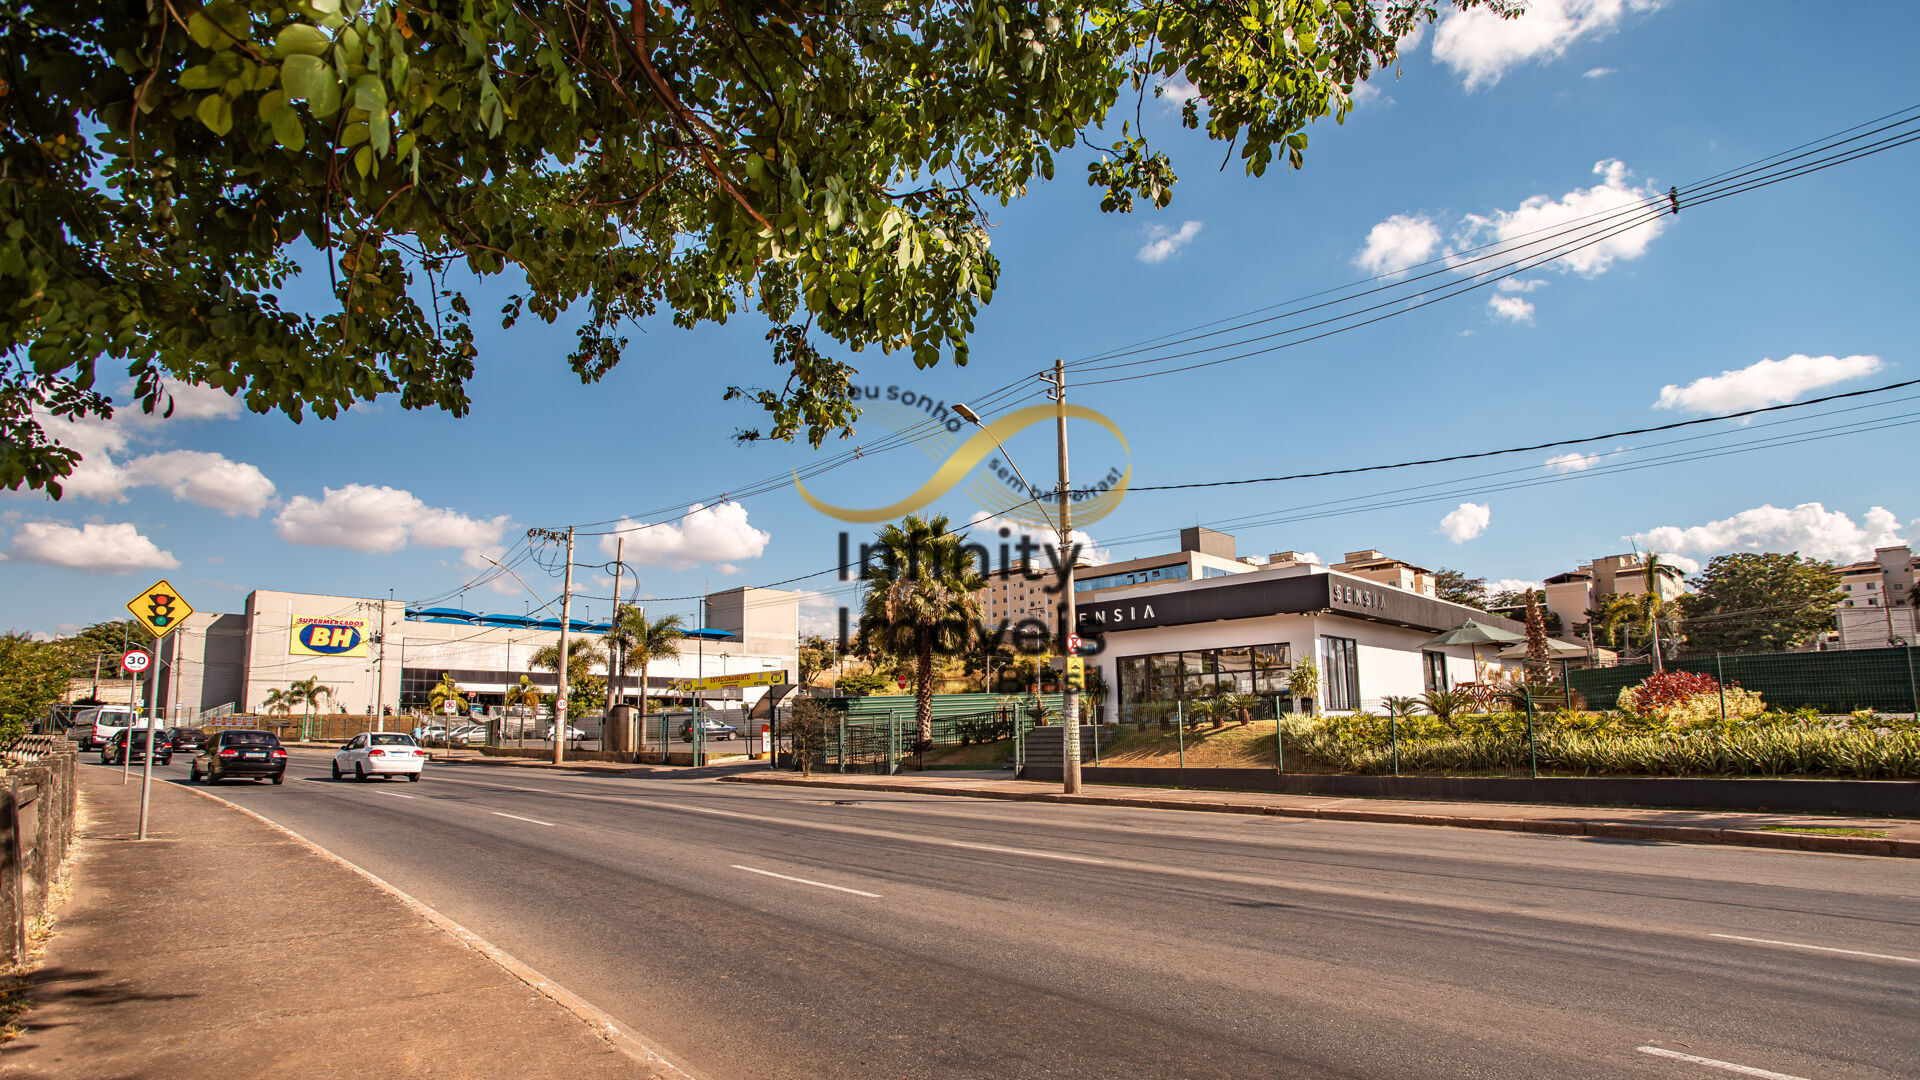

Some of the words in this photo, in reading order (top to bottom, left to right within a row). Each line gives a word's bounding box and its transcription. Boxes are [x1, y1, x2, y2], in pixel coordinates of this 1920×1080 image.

[1333, 584, 1387, 611] SENSIA
[297, 617, 365, 627] SUPERMERCADOS
[1078, 604, 1157, 627] ENSIA
[308, 625, 355, 648] BH
[127, 655, 146, 665] 30
[709, 673, 751, 684] ESTACIONAMENTO
